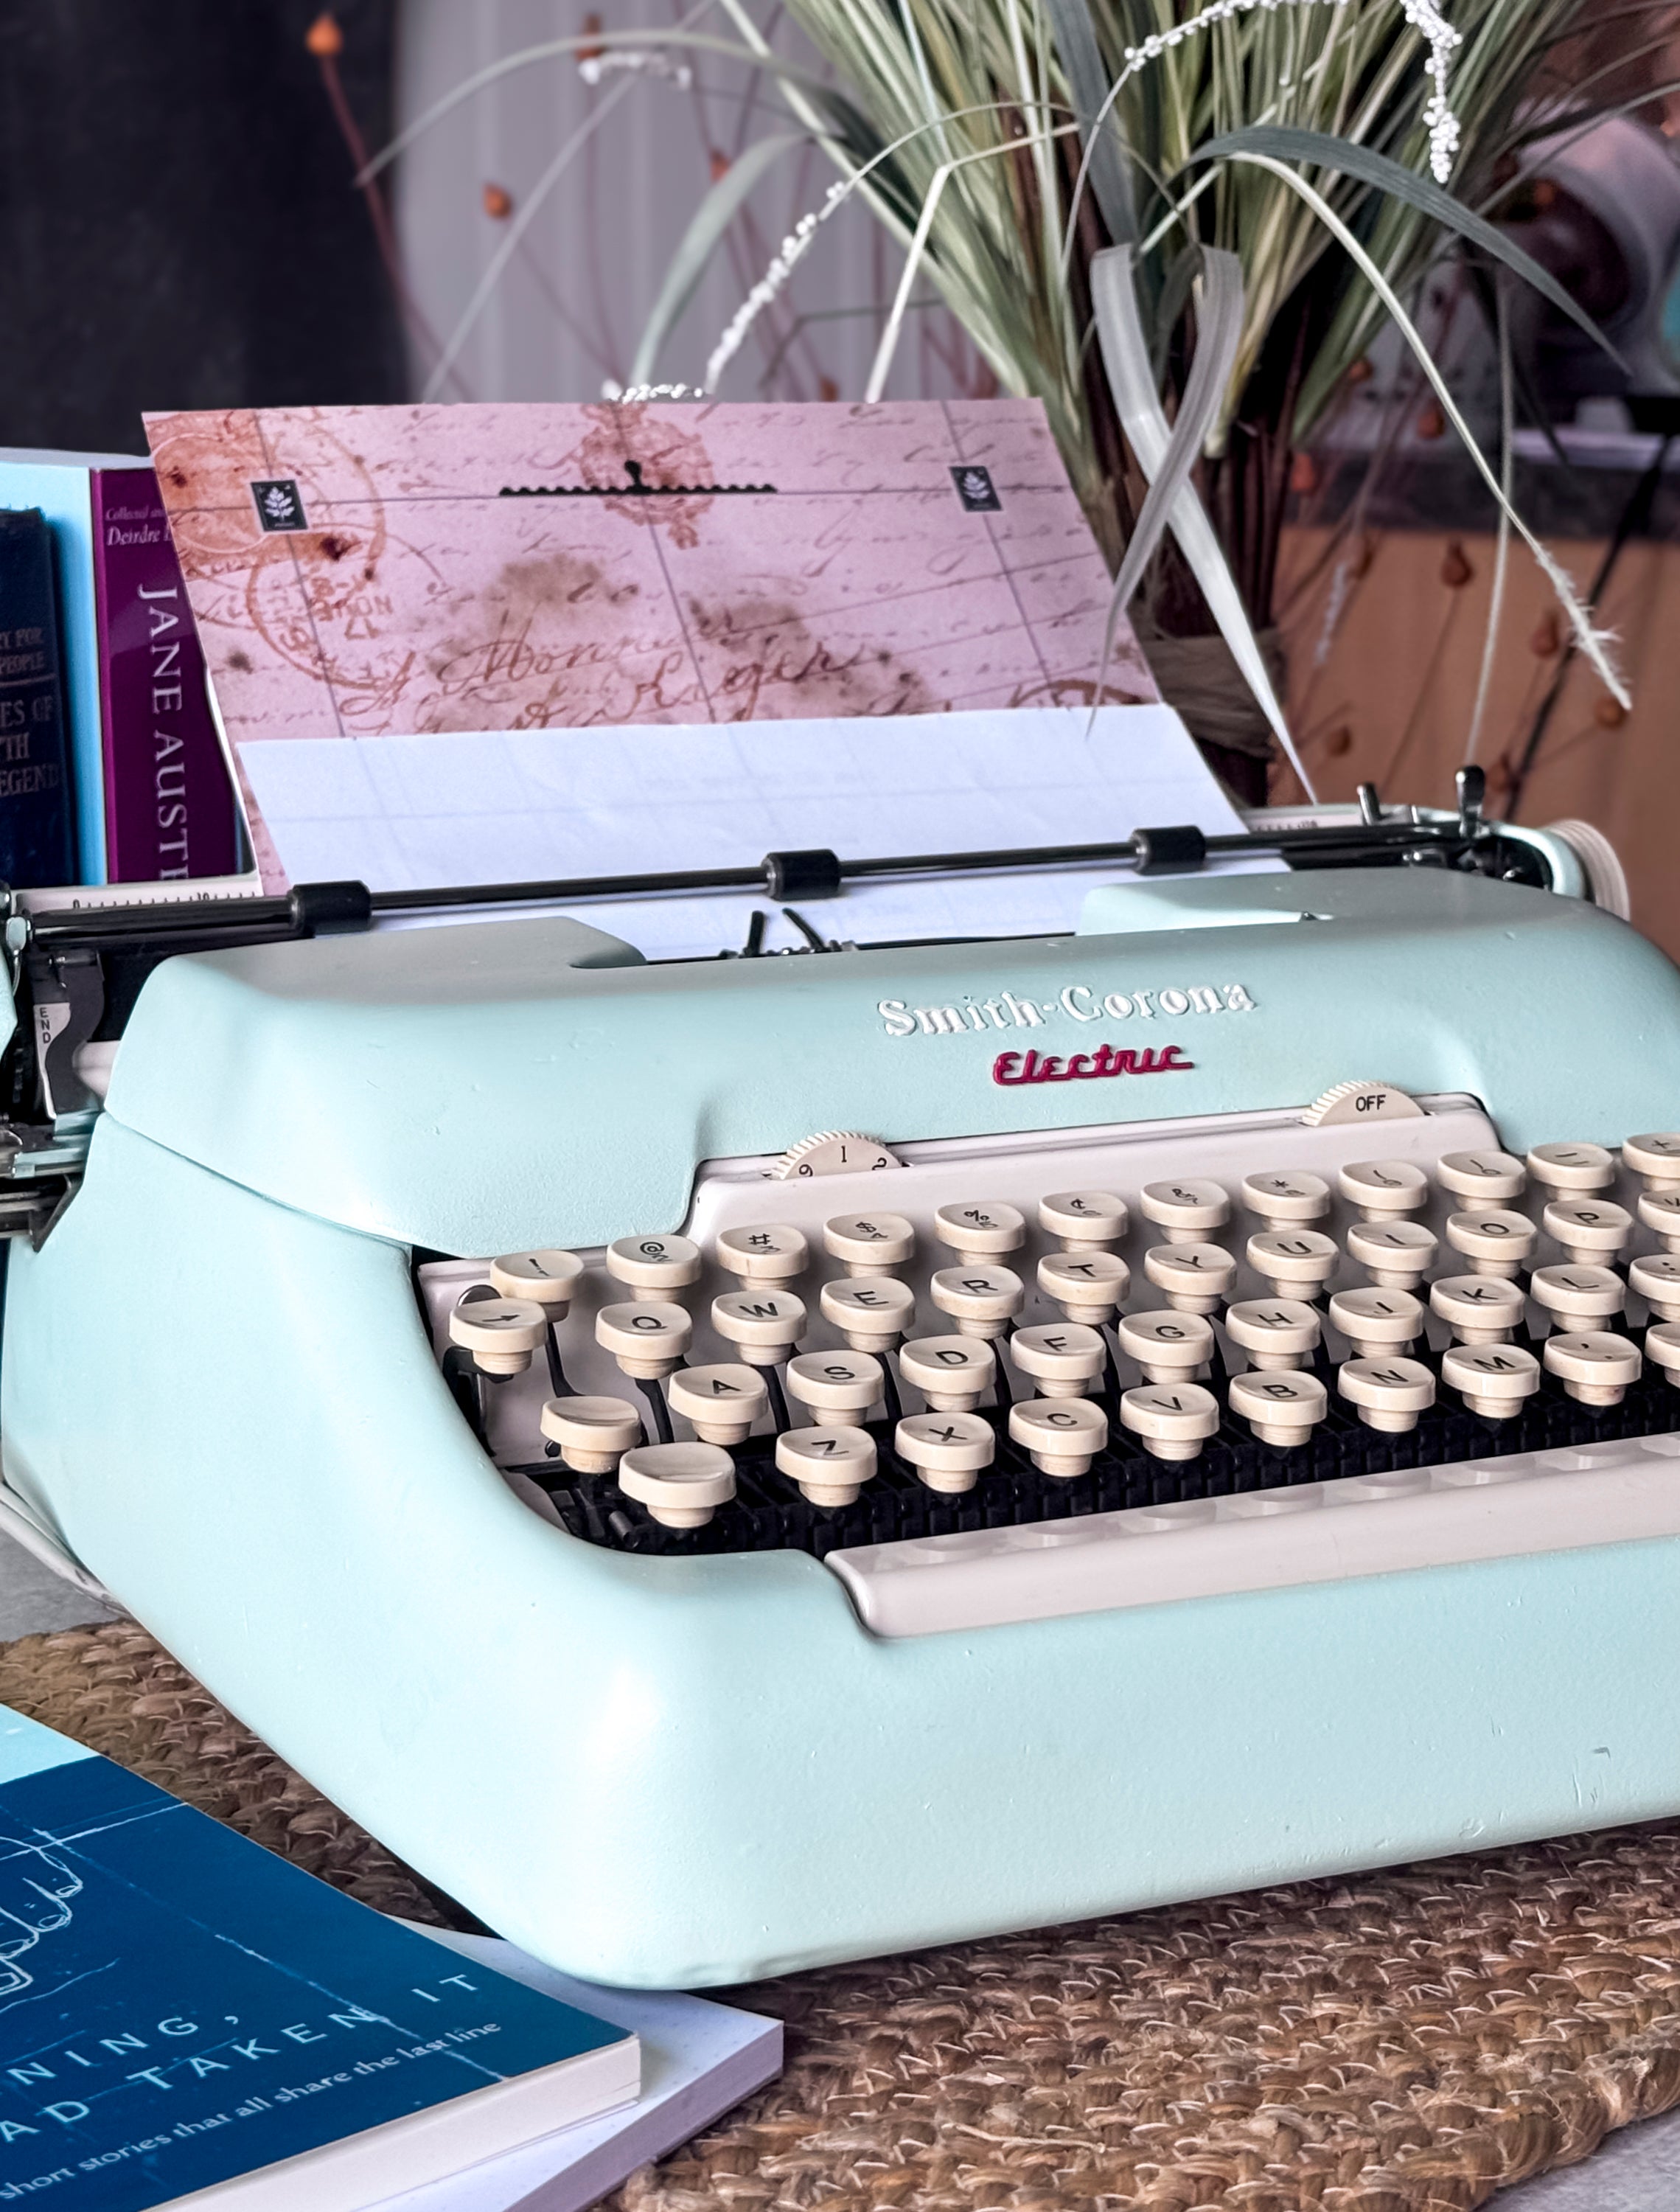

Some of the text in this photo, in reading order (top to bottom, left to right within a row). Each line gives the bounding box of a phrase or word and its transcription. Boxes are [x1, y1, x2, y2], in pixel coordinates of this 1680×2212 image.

[137, 583, 182, 714] JANE
[876, 983, 1258, 1036] Smith-Corona
[39, 1006, 52, 1045] END
[992, 1044, 1194, 1085] Electric
[1355, 1093, 1387, 1112] OFF
[1574, 1211, 1600, 1224] P
[1480, 1222, 1510, 1235] O
[749, 1233, 770, 1245] #
[639, 1241, 664, 1255] @
[1277, 1241, 1312, 1254] U
[1175, 1256, 1204, 1268] Y
[1067, 1263, 1096, 1277] T
[962, 1279, 999, 1293] R
[1561, 1277, 1600, 1289] L
[853, 1291, 889, 1306] E
[1462, 1288, 1498, 1302] K
[739, 1302, 778, 1318] W
[1373, 1301, 1394, 1315] J
[632, 1315, 668, 1329] Q
[1258, 1312, 1294, 1326] H
[1155, 1325, 1185, 1338] G
[1043, 1336, 1067, 1352] F
[935, 1350, 969, 1365] D
[1473, 1355, 1516, 1371] M
[823, 1366, 855, 1380] S
[1370, 1369, 1409, 1384] N
[711, 1378, 741, 1394] A
[1262, 1384, 1298, 1399] B
[1151, 1396, 1183, 1411] V
[1047, 1413, 1078, 1427] C
[928, 1426, 968, 1441] X
[811, 1439, 848, 1456] Z
[125, 2008, 377, 2089] TAKEN
[411, 1974, 478, 2002] IT
[0, 2023, 502, 2199] short stories that all share the last line
